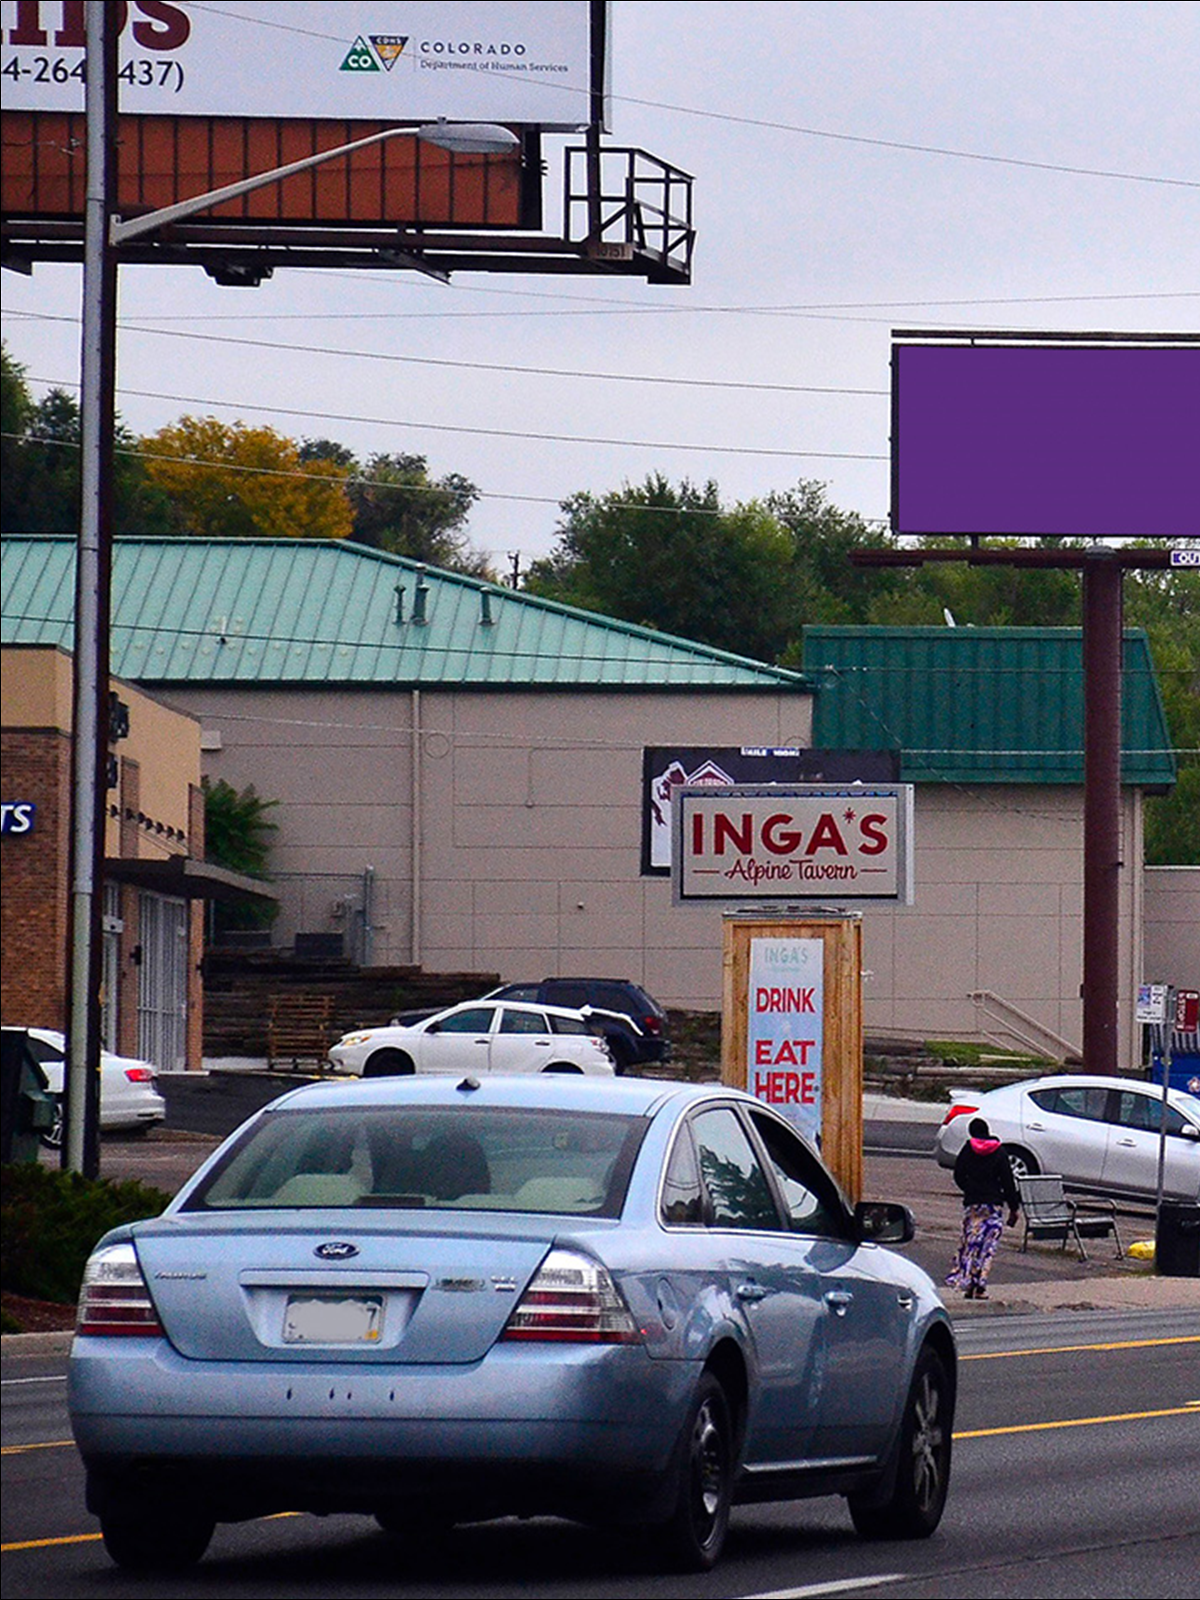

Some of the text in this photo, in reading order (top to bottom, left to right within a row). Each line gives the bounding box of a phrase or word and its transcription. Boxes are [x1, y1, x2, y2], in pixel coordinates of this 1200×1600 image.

[420, 41, 526, 56] COLORADO
[348, 55, 372, 68] CO
[420, 59, 569, 73] Department of Human Services
[692, 807, 888, 856] INGA'S
[724, 858, 858, 886] Alpine Tavern
[764, 947, 809, 964] INGA'S
[755, 987, 816, 1013] DRINK
[755, 1040, 816, 1065] EAT
[754, 1072, 815, 1103] HERE
